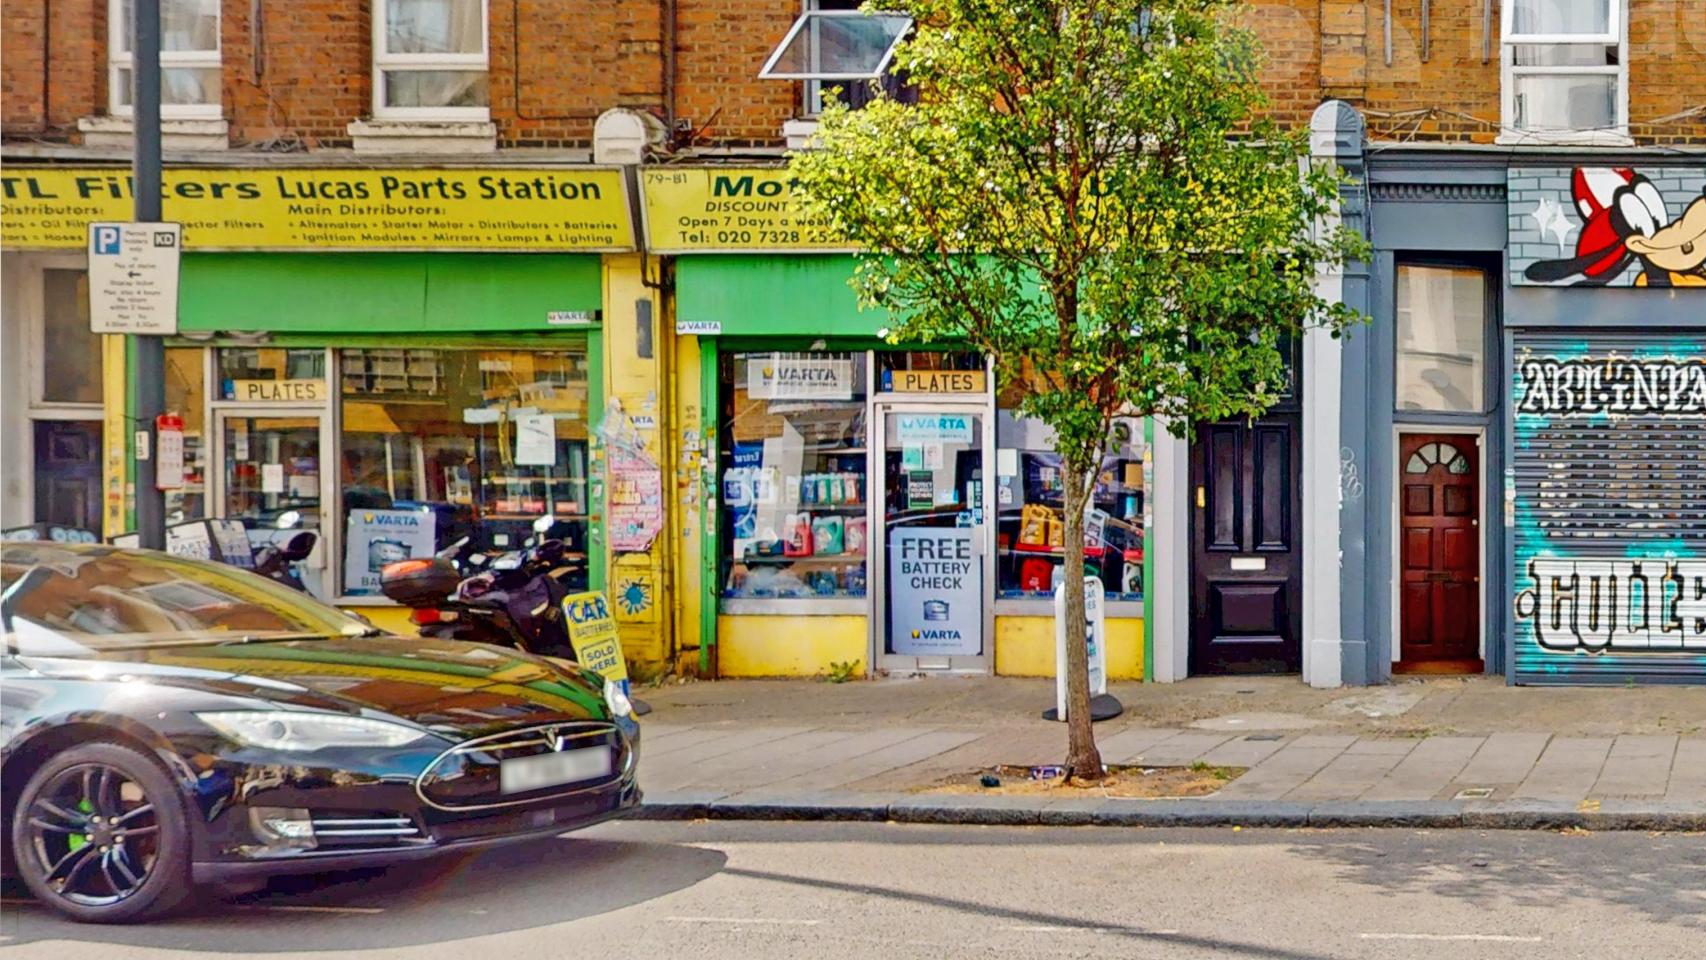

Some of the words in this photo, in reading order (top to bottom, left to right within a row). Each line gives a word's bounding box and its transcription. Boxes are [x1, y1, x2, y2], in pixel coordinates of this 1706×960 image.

[277, 176, 370, 200] Lucas
[381, 176, 467, 200] Parts
[479, 176, 602, 200] Station
[288, 204, 332, 215] Main
[340, 204, 446, 215] Distributors:
[705, 201, 789, 212] DISCOUNT
[224, 220, 264, 228] Filters
[299, 220, 367, 229] Alternators
[382, 220, 422, 229] Starter
[428, 220, 463, 229] Motor
[479, 220, 549, 229] Distributors
[564, 221, 618, 230] Batteries
[678, 216, 718, 229] Open
[724, 217, 732, 227] 7
[738, 217, 774, 228] Days
[780, 219, 789, 227] a
[302, 232, 355, 242] Ignition
[361, 233, 416, 242] Modules
[433, 233, 480, 242] Mirrors
[497, 234, 539, 243] Lamps
[559, 234, 613, 244] Lighting
[679, 230, 710, 243] Tel:
[717, 230, 751, 243] 020
[759, 231, 800, 243] 7328
[687, 322, 720, 331] VARTA
[778, 367, 836, 381] VARTA
[906, 374, 973, 390] PLATES
[247, 383, 316, 399] PLATES
[916, 418, 966, 429] VARTA
[376, 515, 419, 526] VARTA
[902, 538, 971, 559] FREE
[902, 562, 971, 575] BATTERY
[911, 577, 962, 589] CHECK
[567, 596, 609, 624] CAR
[922, 629, 961, 639] VARTA
[586, 645, 615, 662] SOLD
